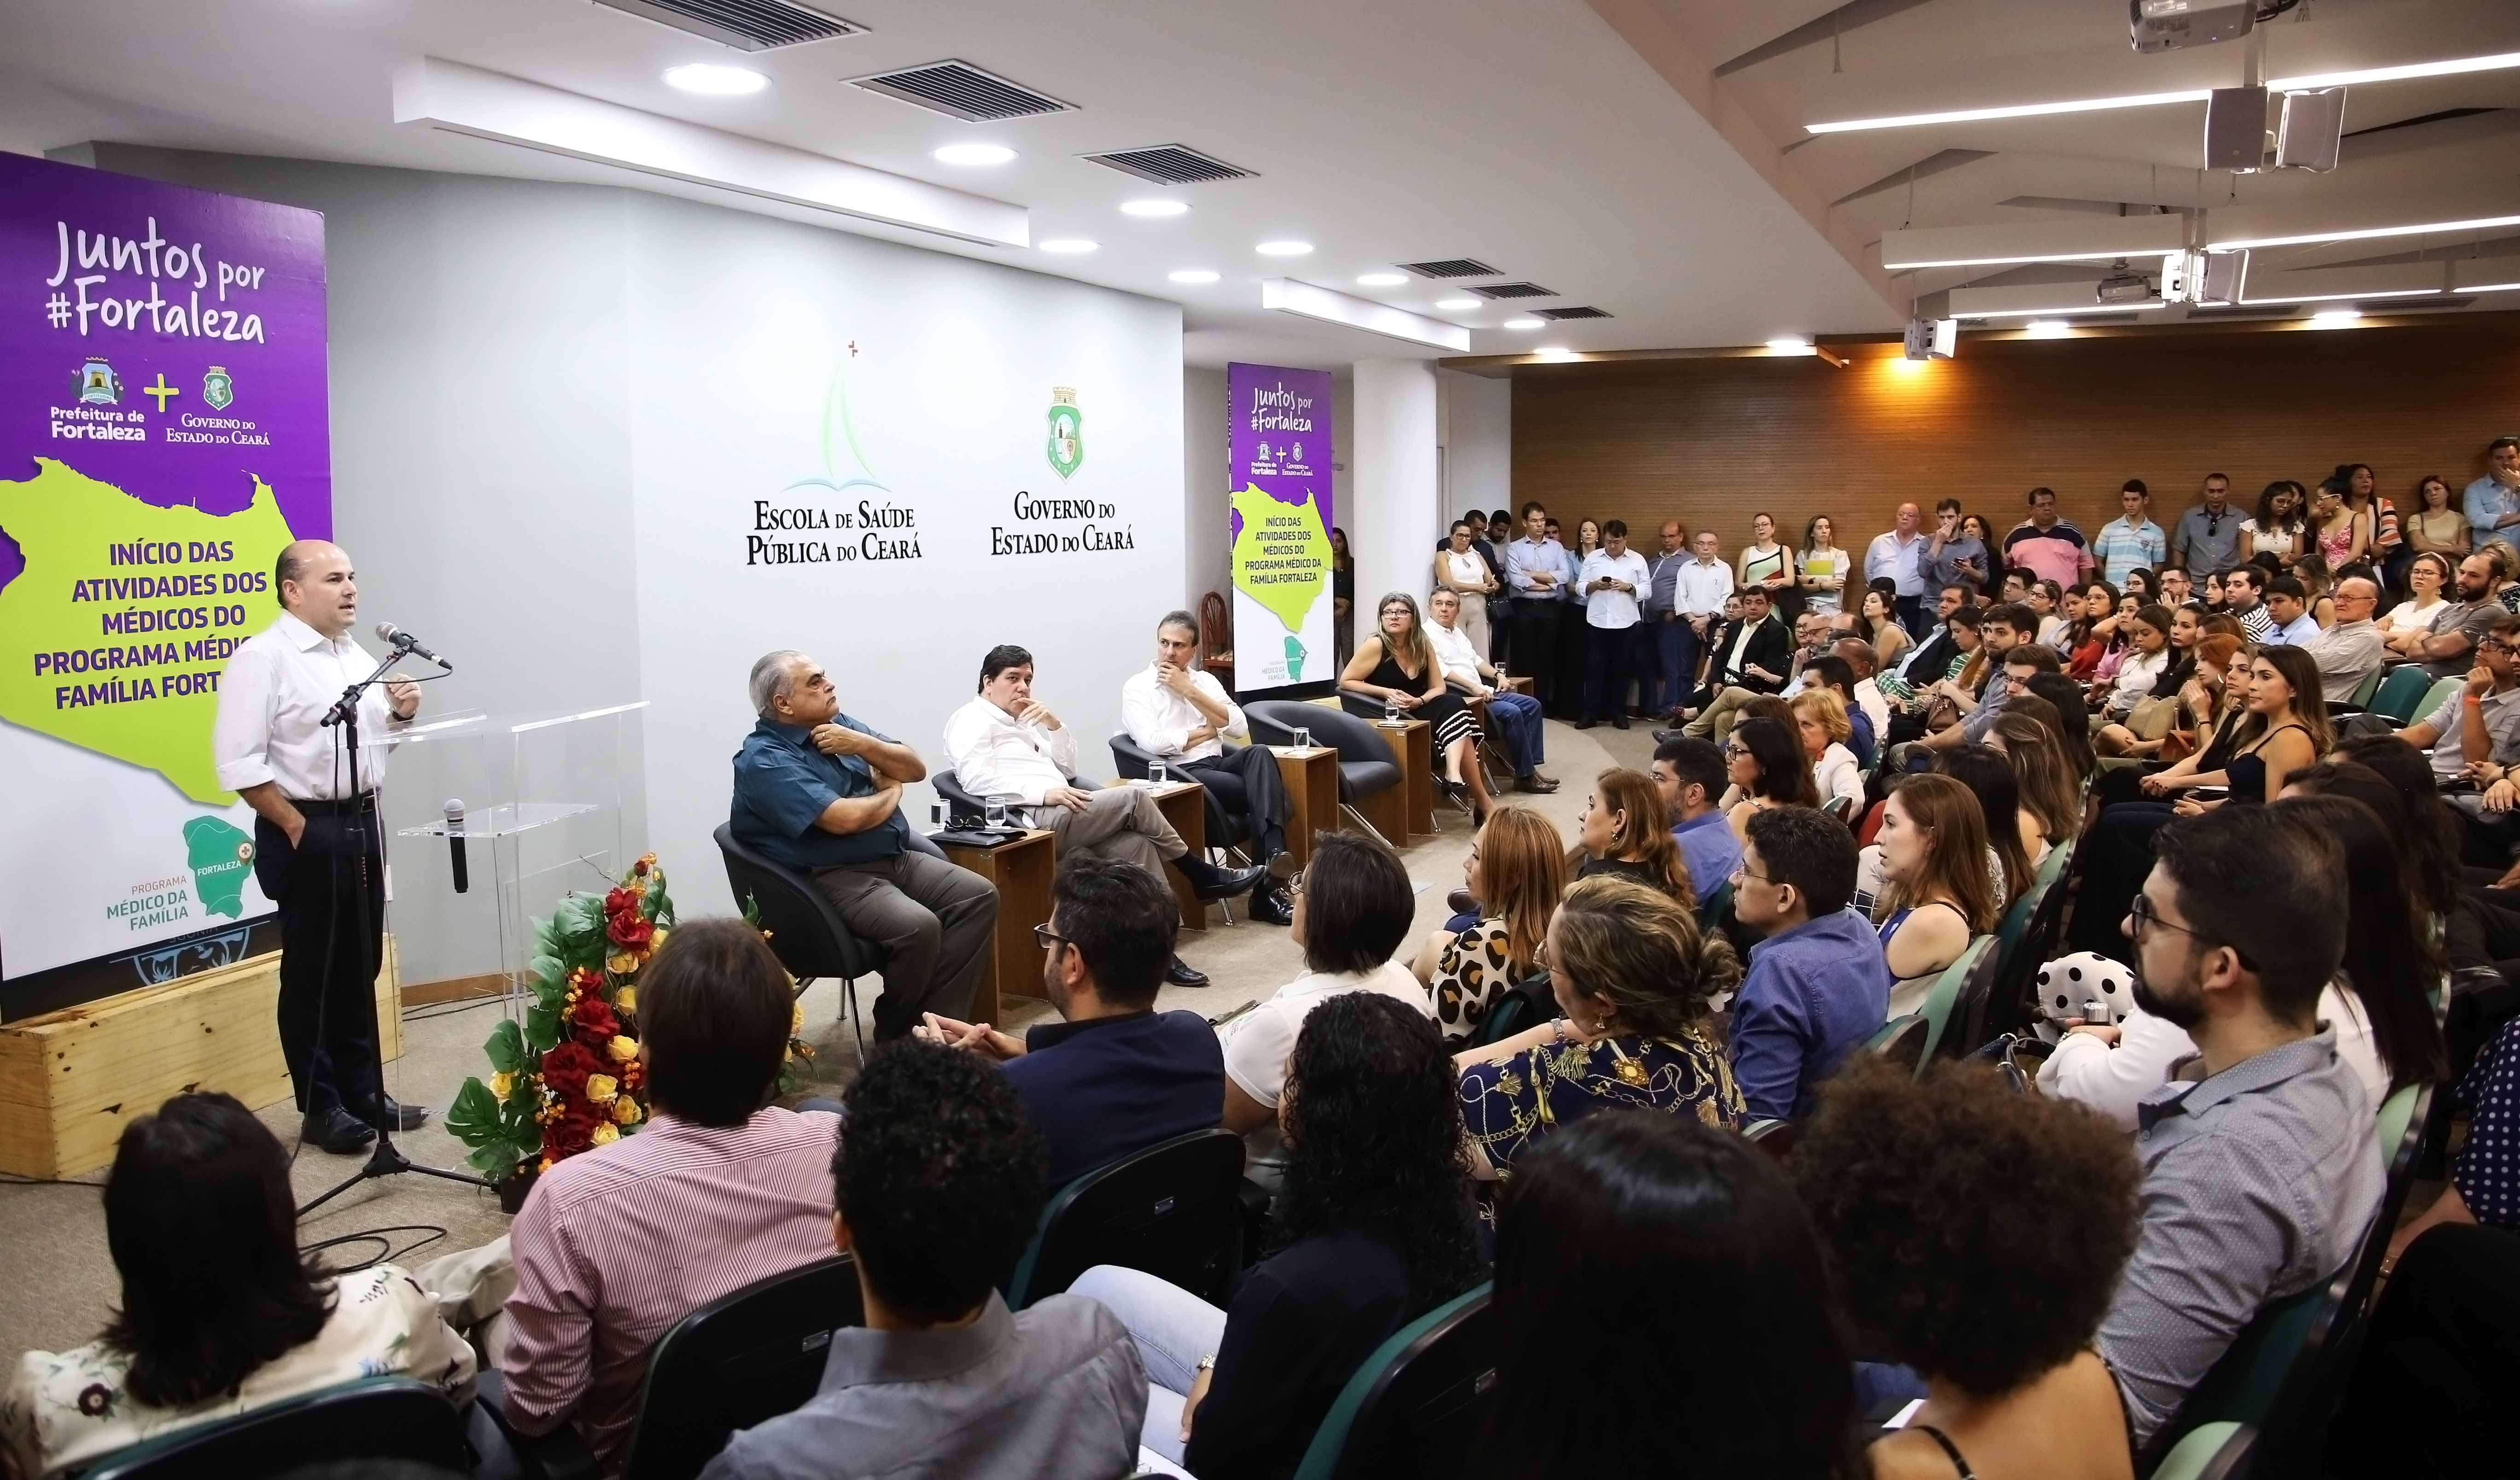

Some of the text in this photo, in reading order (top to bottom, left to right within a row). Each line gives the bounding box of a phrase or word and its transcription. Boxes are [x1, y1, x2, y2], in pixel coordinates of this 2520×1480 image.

[47, 216, 265, 301] Juntos por
[46, 275, 265, 344] #Fortaleza
[1251, 381, 1312, 414] Juntos por
[51, 406, 145, 423] Prefeitura de
[181, 413, 240, 429] GOVERNO
[1251, 408, 1312, 433] #Fortaleza
[52, 421, 146, 442] Fortaleza
[166, 428, 213, 444] ESTADO
[231, 431, 270, 446] CEARÁ
[754, 500, 830, 530] ESCOLA
[858, 500, 915, 529] SAÚDE
[1014, 491, 1095, 520] GOVERNO
[1266, 515, 1301, 527] INÍCIO DAS
[747, 534, 831, 565] PÚBLICA
[861, 532, 922, 560] CEARÁ
[991, 527, 1058, 555] ESTADO
[1083, 524, 1134, 550] CEARÁ
[1255, 531, 1311, 542] ATIVIDADES DOS
[1263, 543, 1305, 555] MÉDICOS DO
[110, 537, 233, 565] INÍCIO DAS
[1245, 557, 1321, 571] PROGRAMA MÉDICO DA
[72, 571, 267, 602] ATIVIDADES DOS
[1250, 572, 1317, 585] FAMÍLIA FORTALEZA
[102, 605, 245, 635] MÉDICOS DO
[34, 634, 252, 676] PROGRAMA MÉDI
[1262, 666, 1278, 674] MÉDICO
[56, 676, 157, 709] FAMÍLIA
[197, 860, 242, 876] FORTALEZA
[132, 875, 187, 895] PROGRAMA
[107, 889, 187, 919] MÉDICO DA
[130, 906, 189, 931] FAMÍLIA
